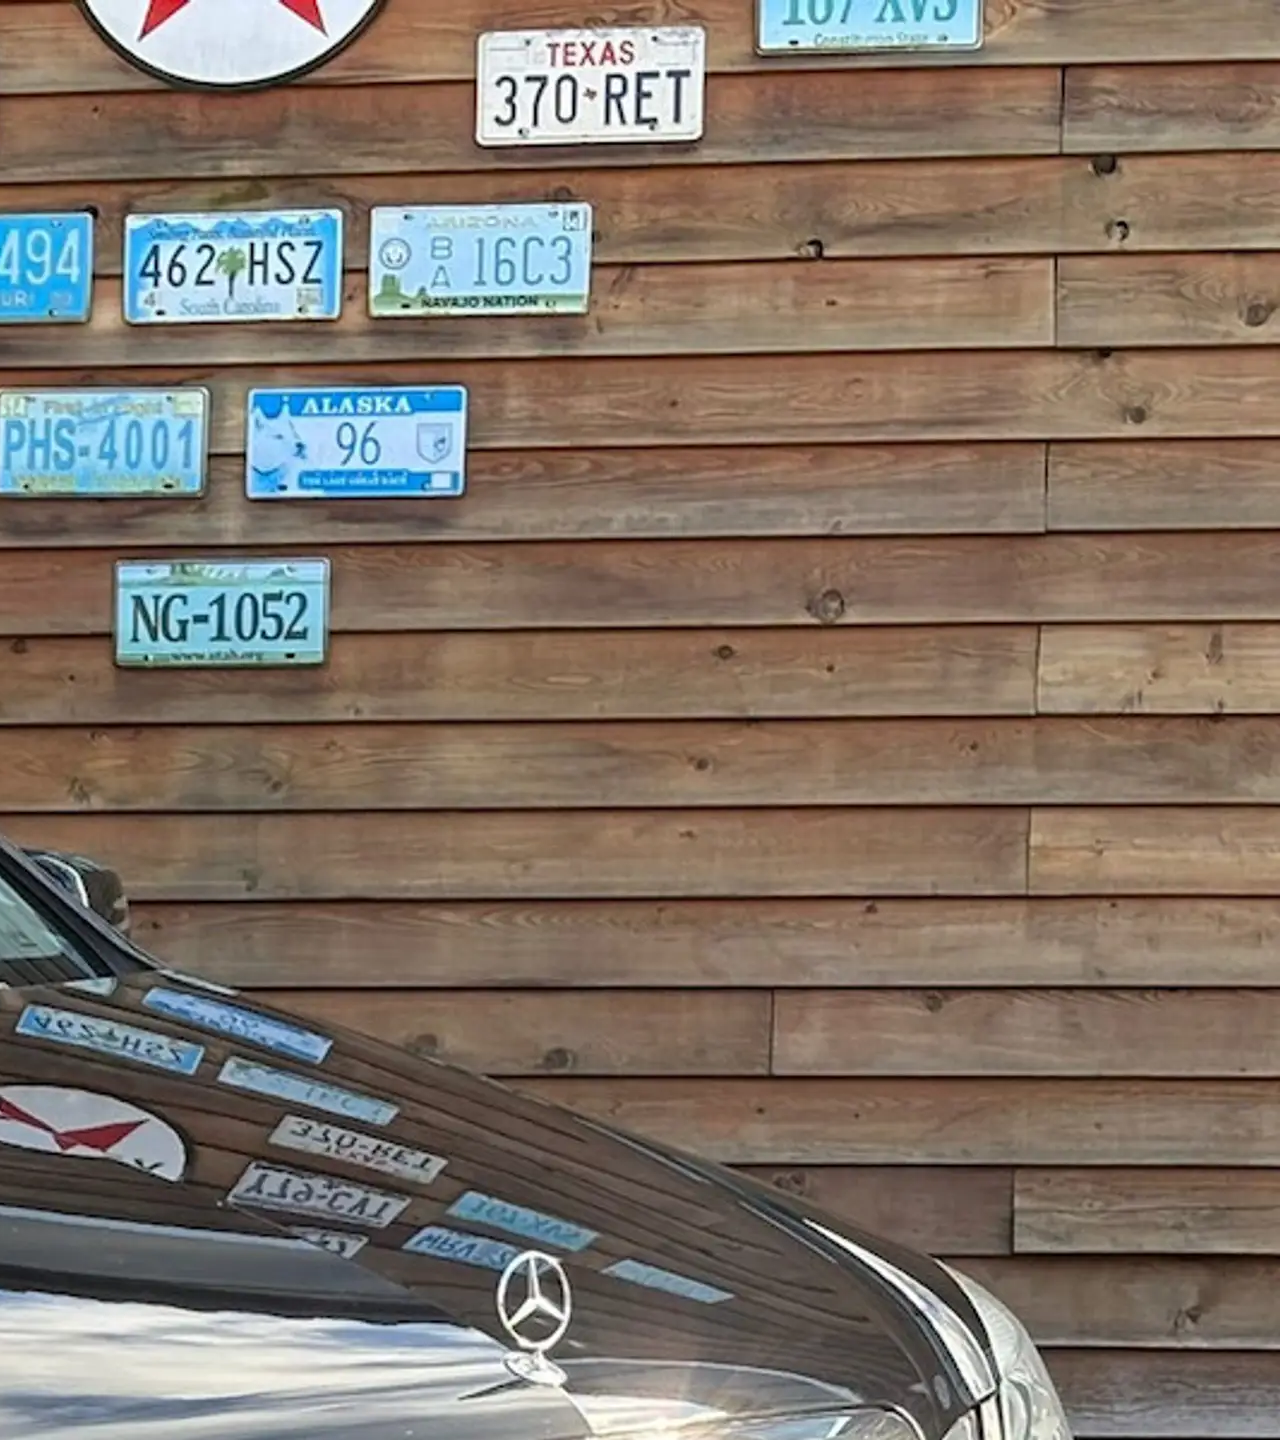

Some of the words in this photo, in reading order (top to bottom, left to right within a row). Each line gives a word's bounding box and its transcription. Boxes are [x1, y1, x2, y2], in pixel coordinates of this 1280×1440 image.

[546, 41, 635, 67] TEXAS
[139, 243, 216, 289] 462
[248, 240, 324, 286] HSZ
[179, 298, 221, 315] South
[223, 297, 282, 315] Carolina
[420, 295, 481, 308] NAVAJO
[483, 294, 539, 307] NATION
[301, 395, 413, 415] ALASKA
[336, 420, 382, 467] 96
[130, 588, 309, 644] NG-1052
